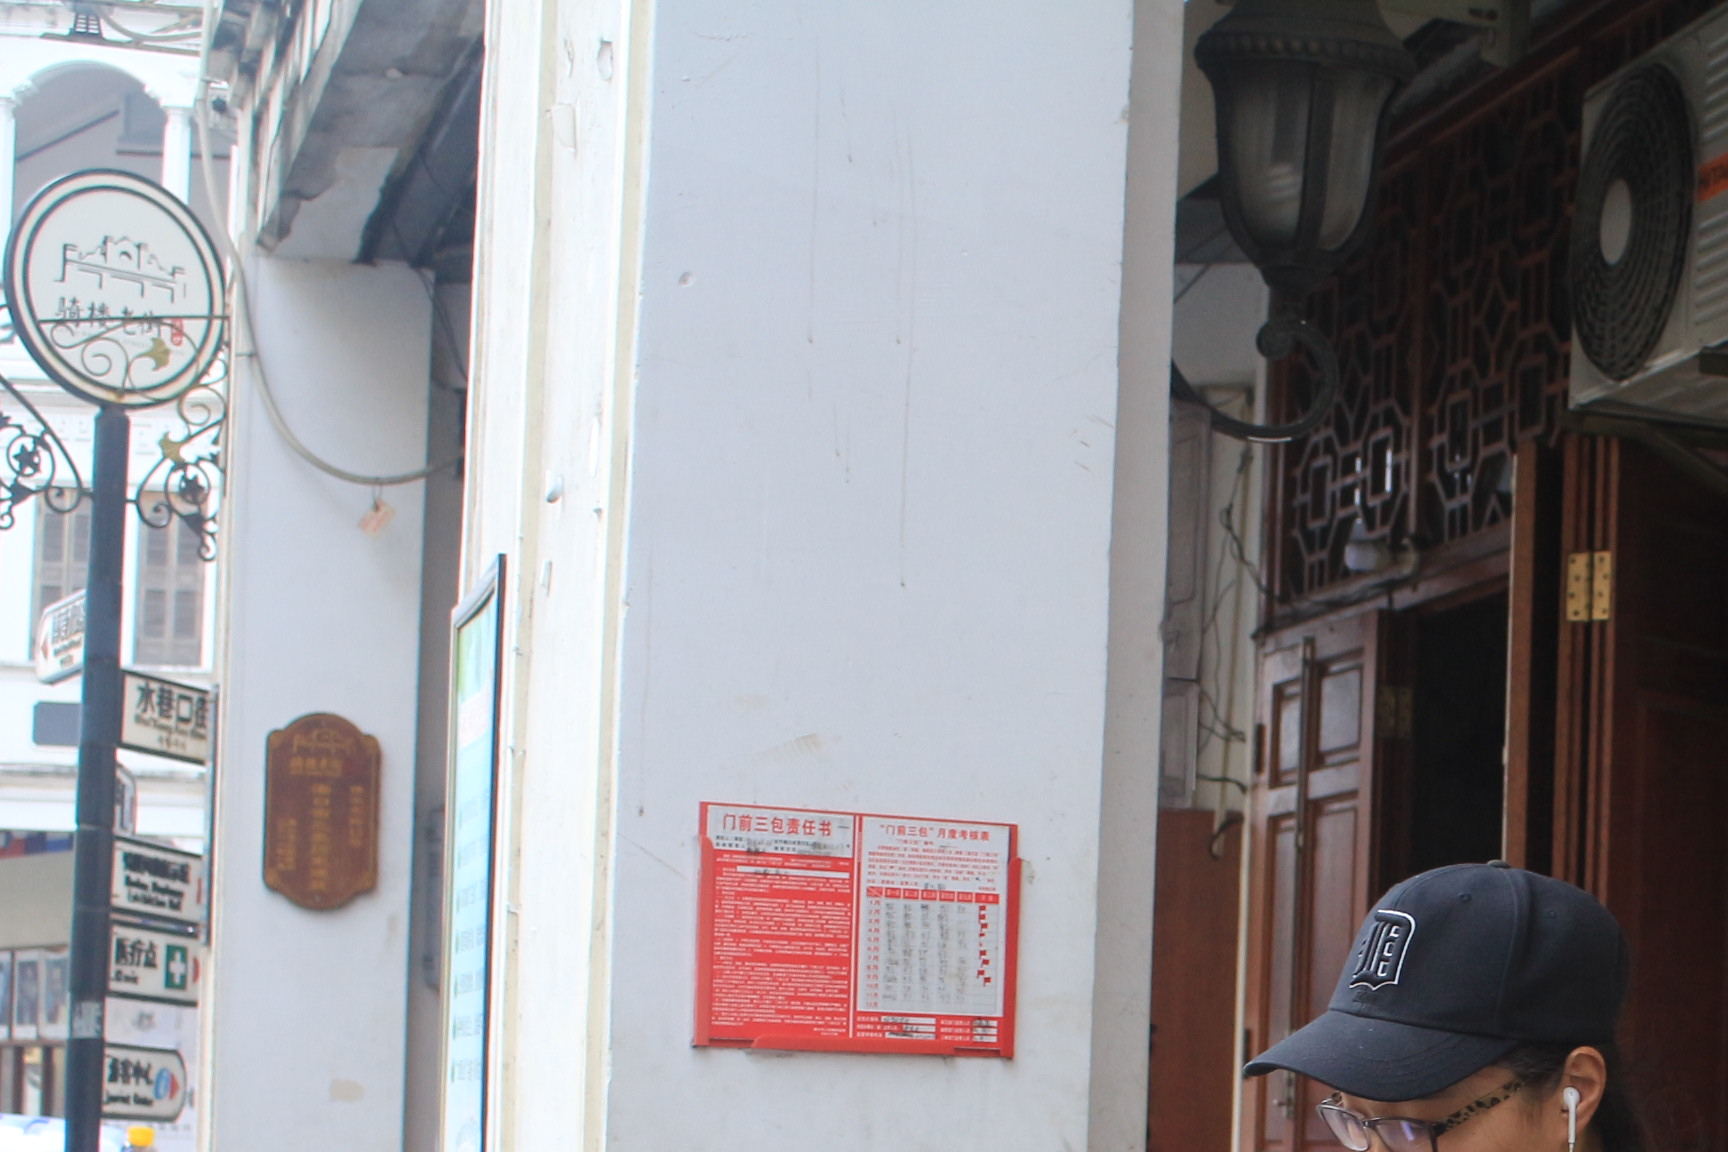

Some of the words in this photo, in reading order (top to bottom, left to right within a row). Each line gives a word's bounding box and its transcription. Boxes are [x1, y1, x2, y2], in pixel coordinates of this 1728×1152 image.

[723, 813, 833, 837] 门前三包责任书
[115, 937, 158, 969] 医疗点
